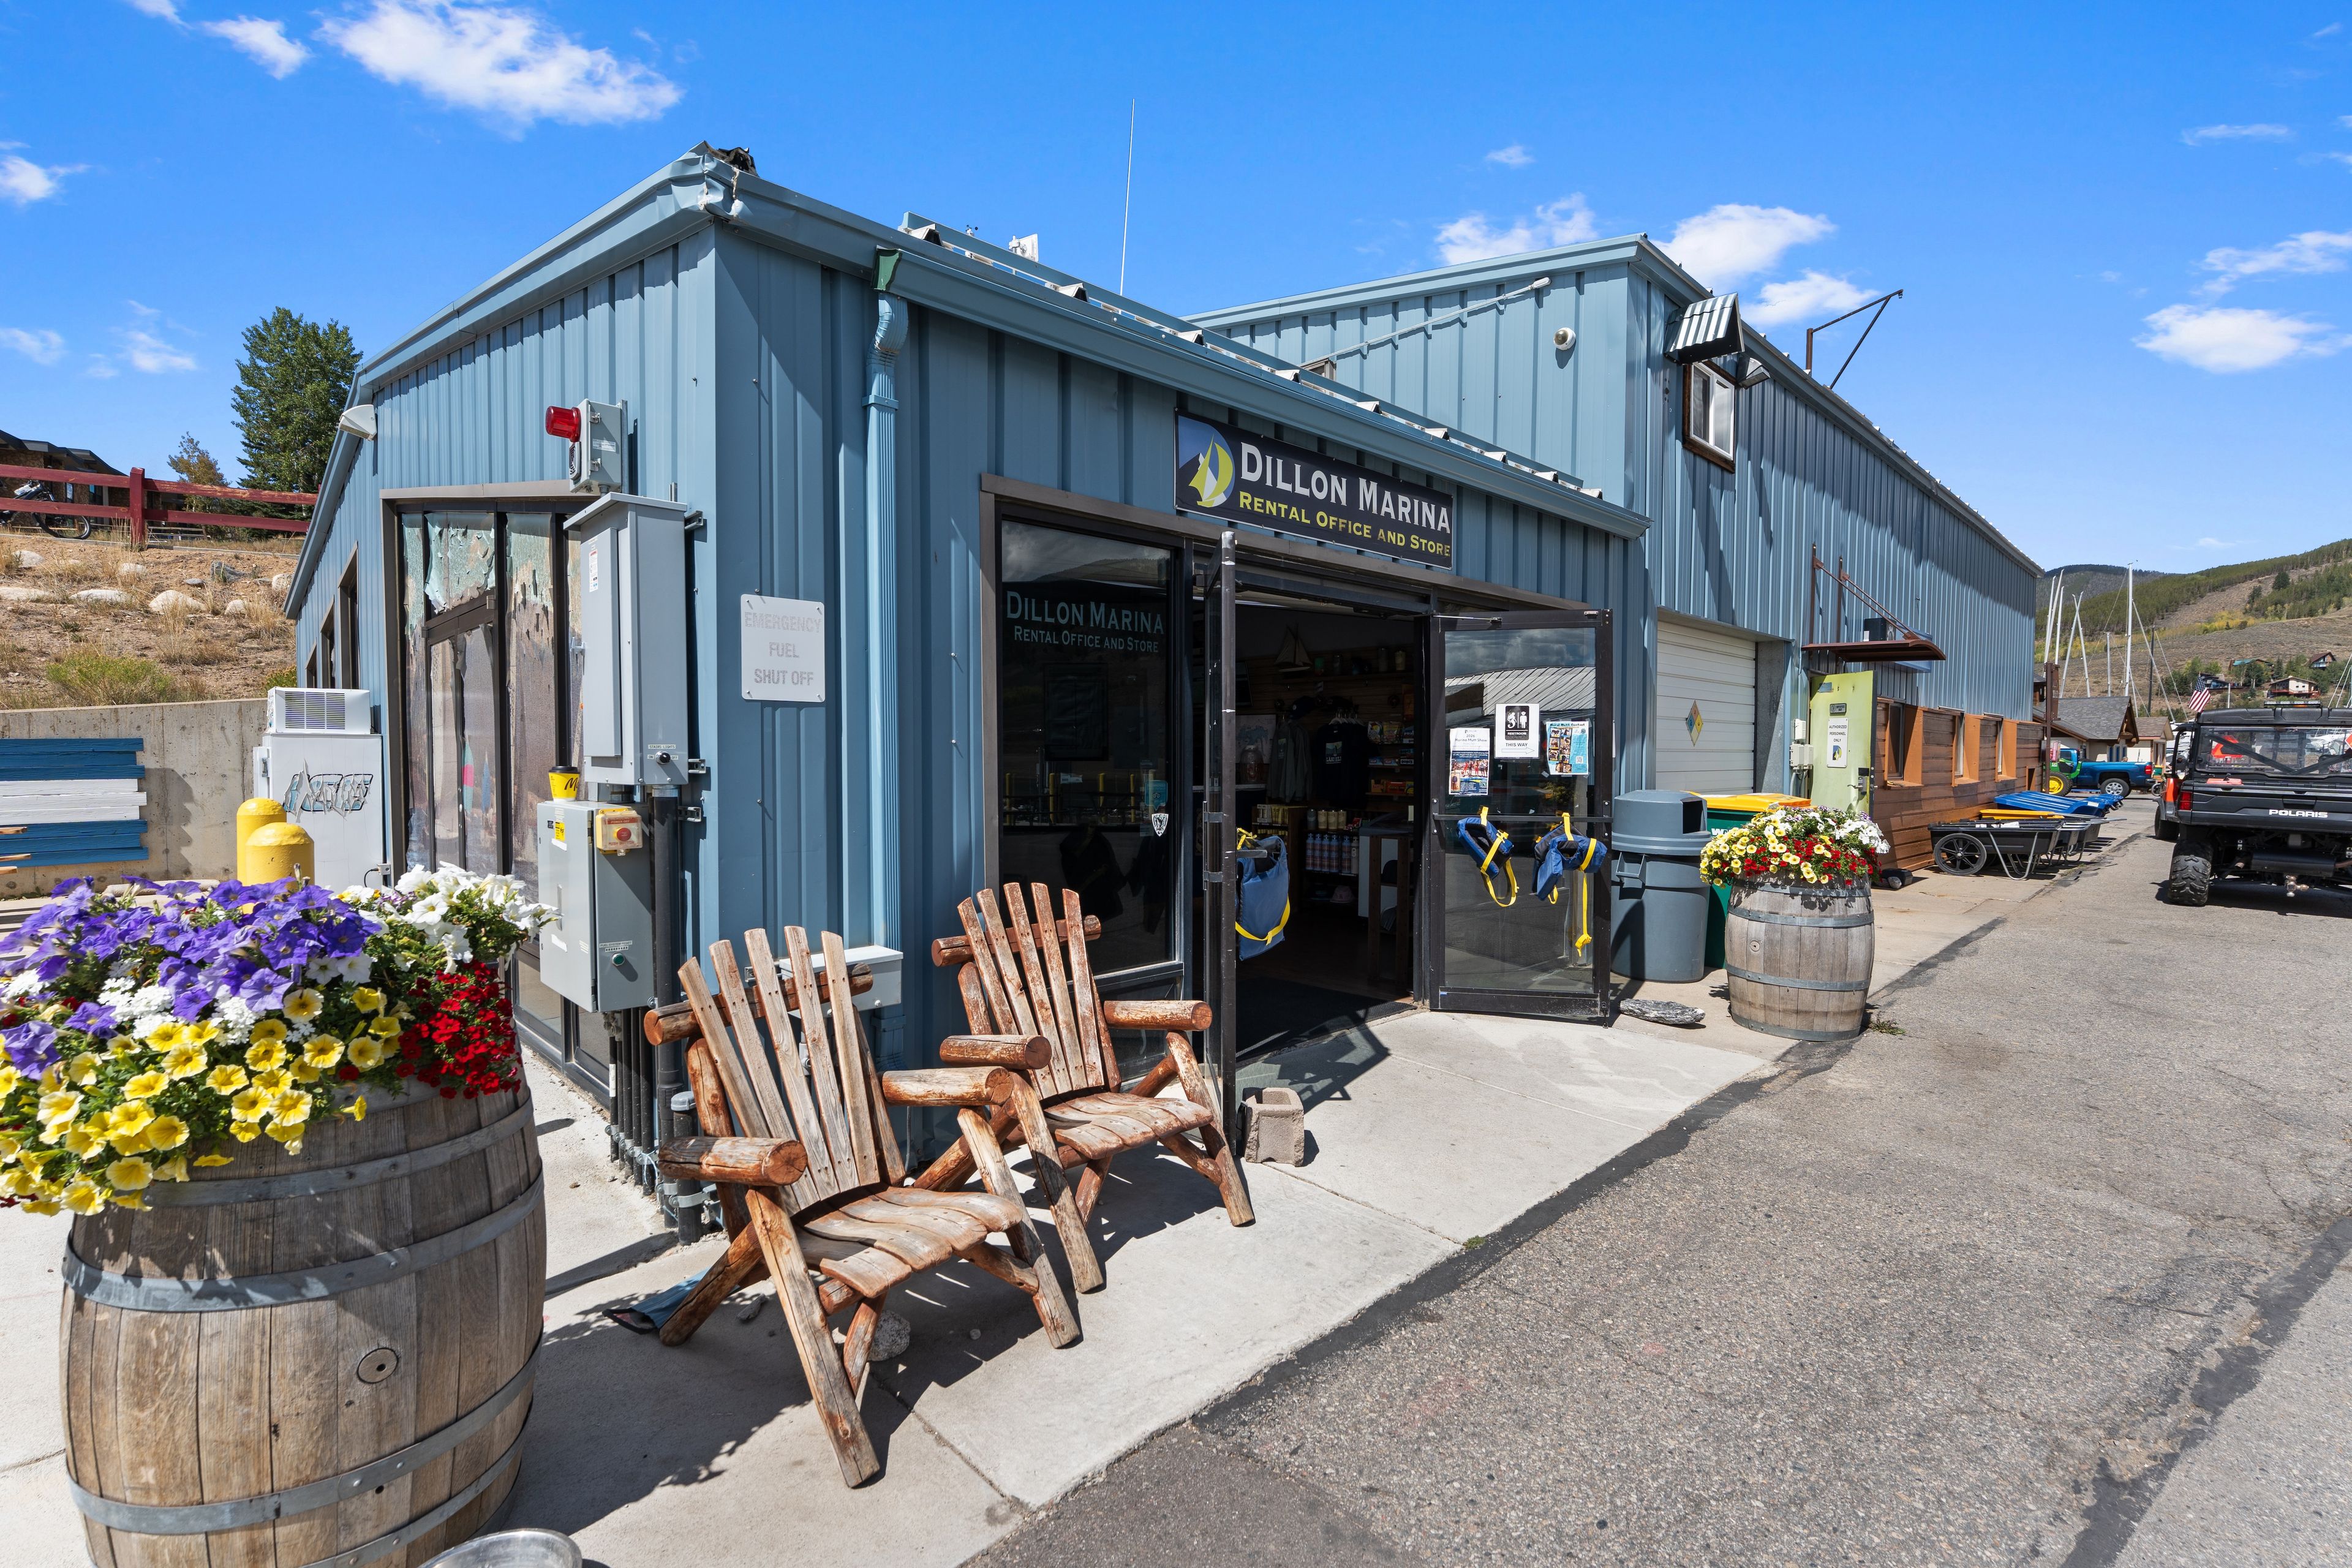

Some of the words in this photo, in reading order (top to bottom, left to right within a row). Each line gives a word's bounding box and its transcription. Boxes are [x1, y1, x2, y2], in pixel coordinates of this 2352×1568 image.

[1240, 442, 1347, 506] DILLON
[1359, 477, 1451, 533] MARINA
[1239, 491, 1310, 524] RENTAL
[1316, 511, 1372, 538] OFFICE
[1377, 528, 1406, 546] AND
[1410, 534, 1451, 557] STORE
[744, 611, 822, 633] EMERGENCY
[1006, 591, 1084, 627] DILLON
[1090, 601, 1164, 635] MARINA
[769, 641, 799, 658] FUEL
[1014, 625, 1059, 644] RENTAL
[1061, 630, 1101, 648] OFFICE
[1103, 636, 1125, 650] AND
[1126, 636, 1159, 653] STORE
[754, 668, 788, 685] SHUT
[791, 671, 814, 686] OFF
[2268, 809, 2328, 818] POLARIS
